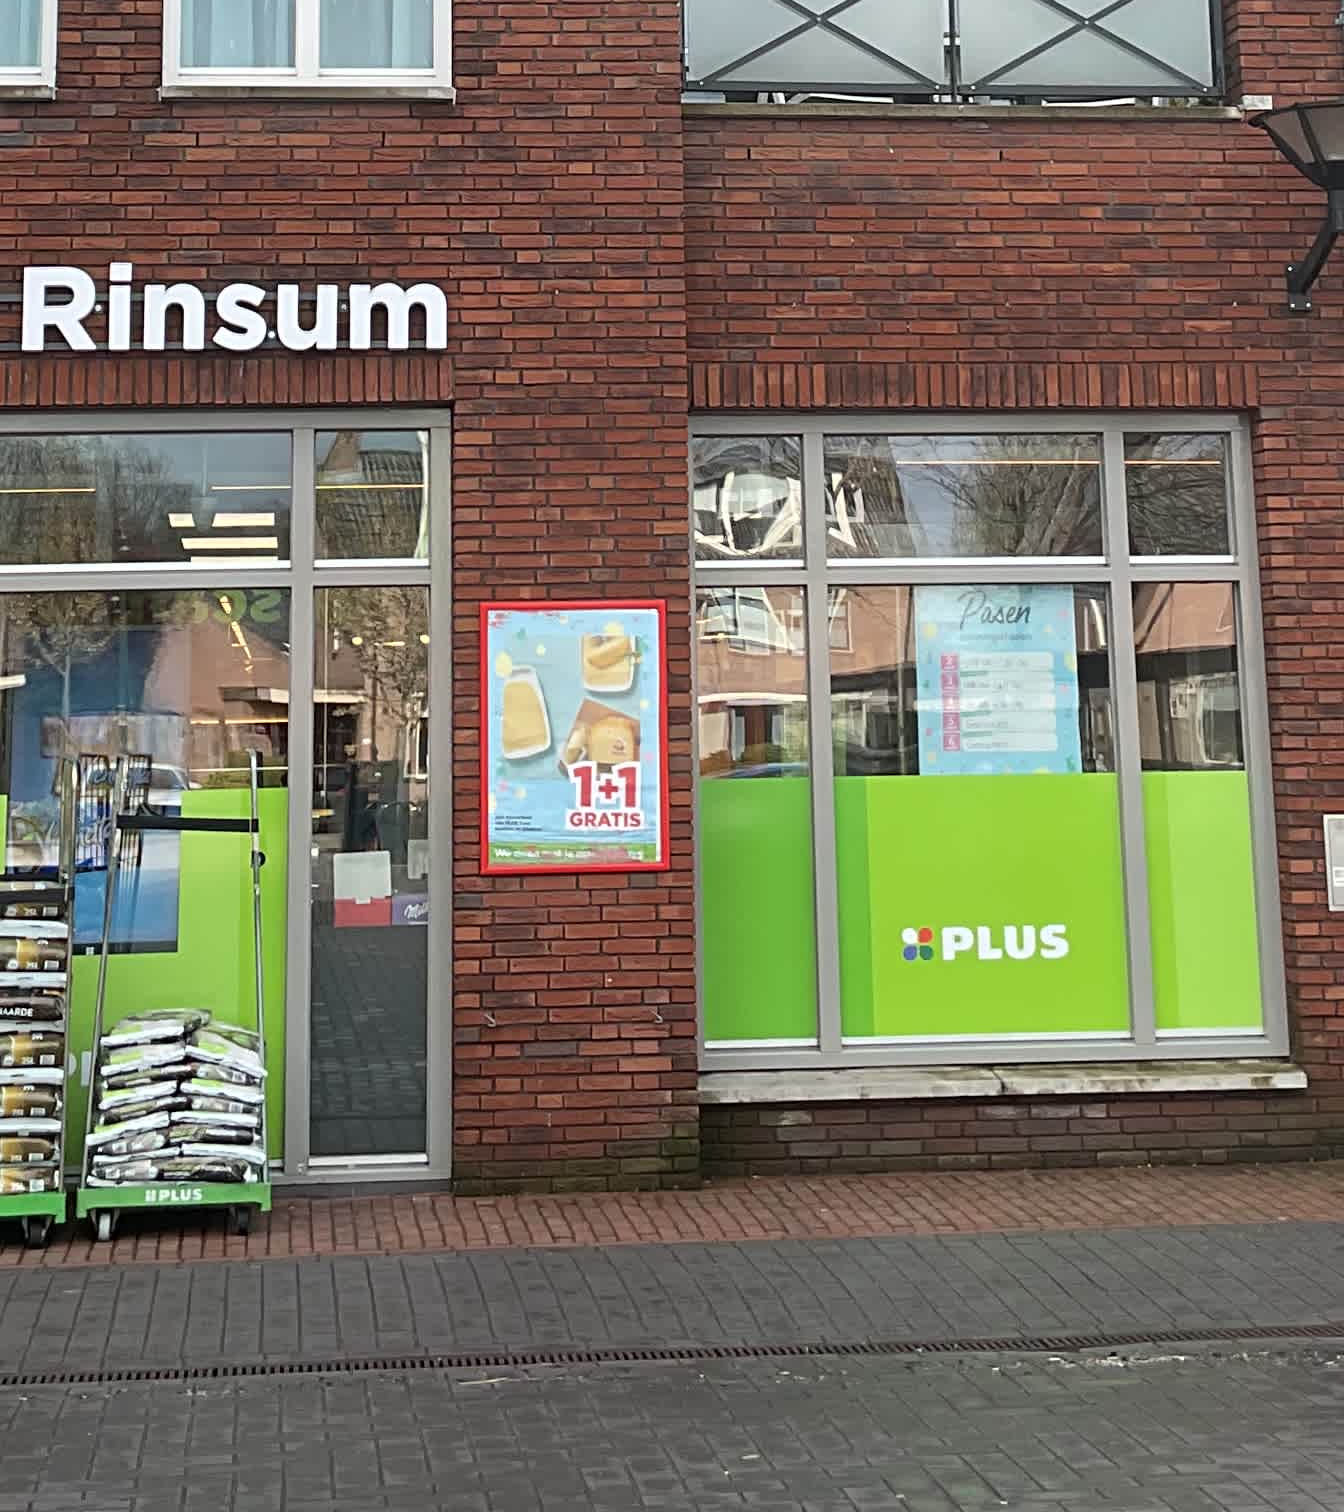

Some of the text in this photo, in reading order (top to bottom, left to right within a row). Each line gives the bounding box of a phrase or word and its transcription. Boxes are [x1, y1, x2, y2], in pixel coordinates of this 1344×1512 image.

[19, 261, 449, 353] Rinsum
[957, 589, 1032, 630] Pasen
[573, 765, 637, 808] 1+1
[569, 811, 642, 828] GRATIS
[941, 923, 1070, 961] PLUS
[158, 1189, 203, 1202] PLUS
